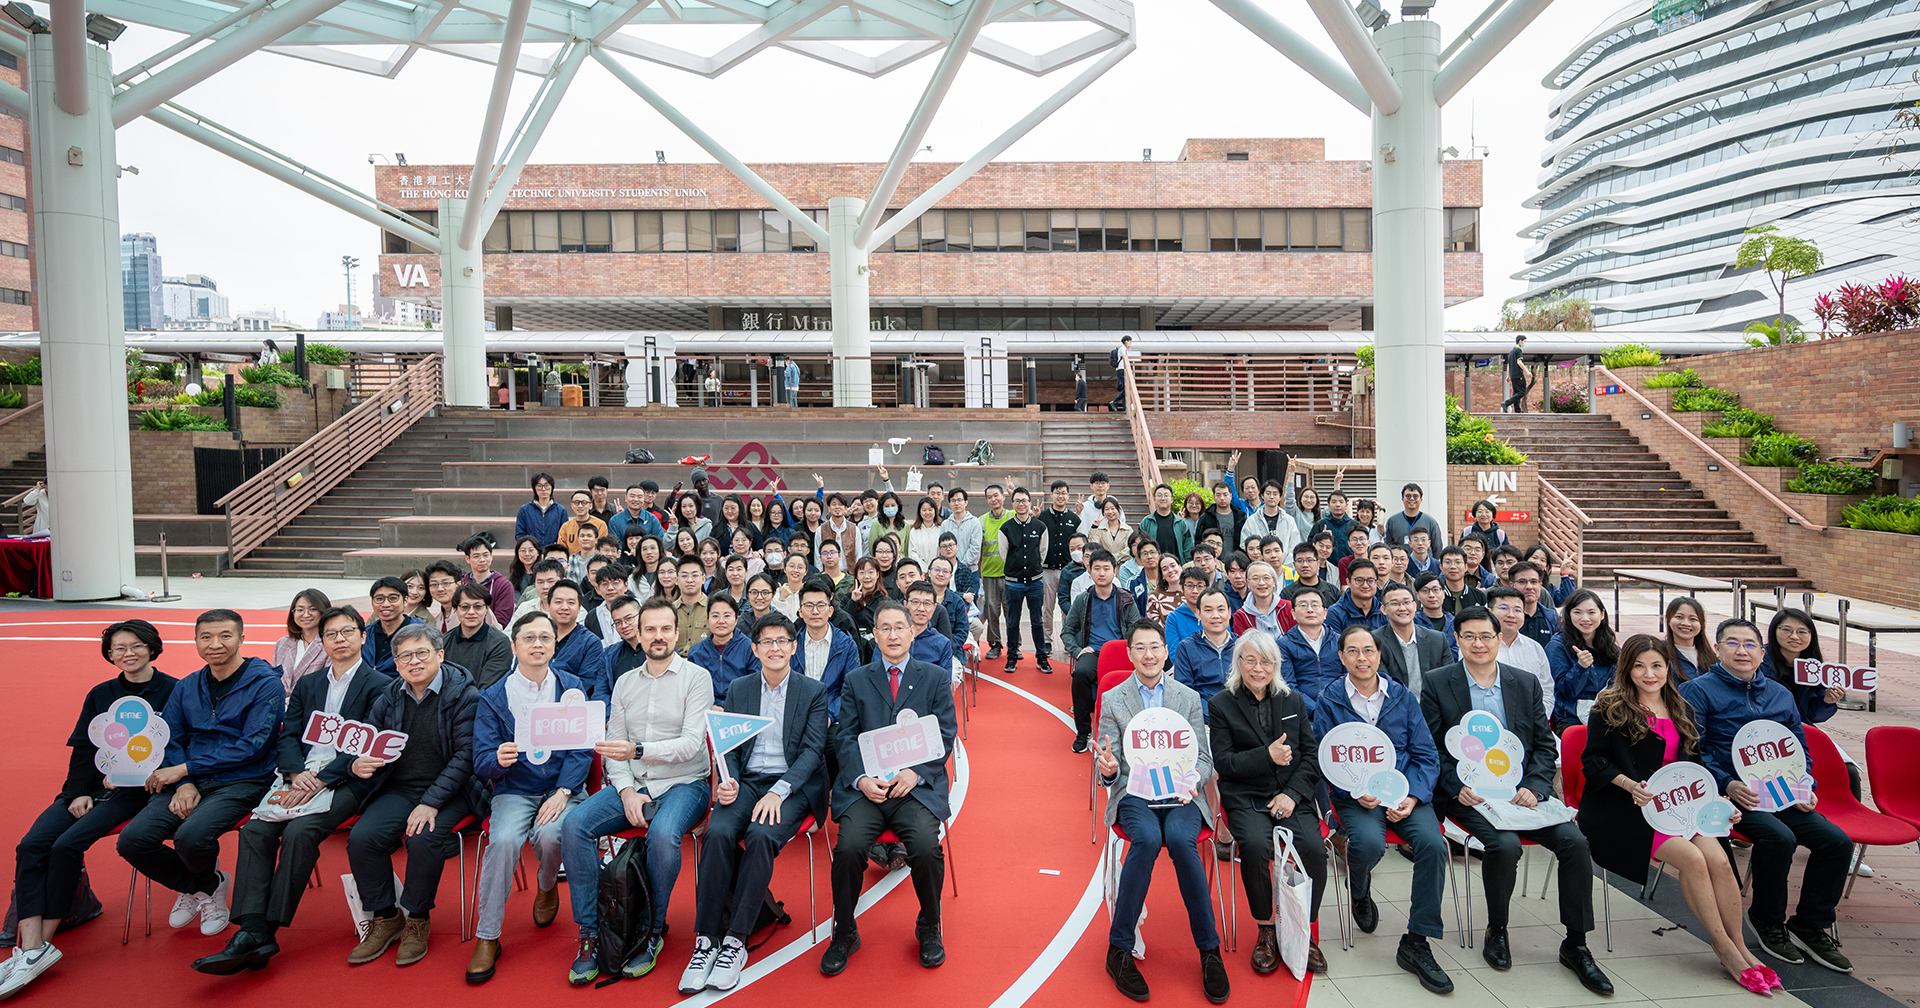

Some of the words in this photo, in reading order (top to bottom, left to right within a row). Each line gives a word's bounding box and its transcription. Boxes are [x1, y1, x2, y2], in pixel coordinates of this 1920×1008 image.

[399, 189, 420, 199] THE
[422, 189, 451, 199] HONG
[453, 189, 469, 199] KO
[486, 188, 555, 198] PTECHNIC
[557, 188, 617, 198] UNIVERSITY
[618, 188, 672, 198] STUDENTS'
[675, 187, 707, 197] UNION
[392, 263, 431, 288] VA
[742, 312, 784, 331] 銀行
[1477, 471, 1517, 492] MN
[569, 534, 575, 543] U
[1797, 660, 1876, 691] BME
[305, 713, 405, 761] BME
[535, 717, 585, 736] BME
[719, 720, 753, 740] BME
[880, 732, 924, 760] BME
[1131, 728, 1190, 749] BME
[1331, 744, 1385, 764] BME
[1738, 736, 1796, 767] BME
[1652, 778, 1707, 813] BME
